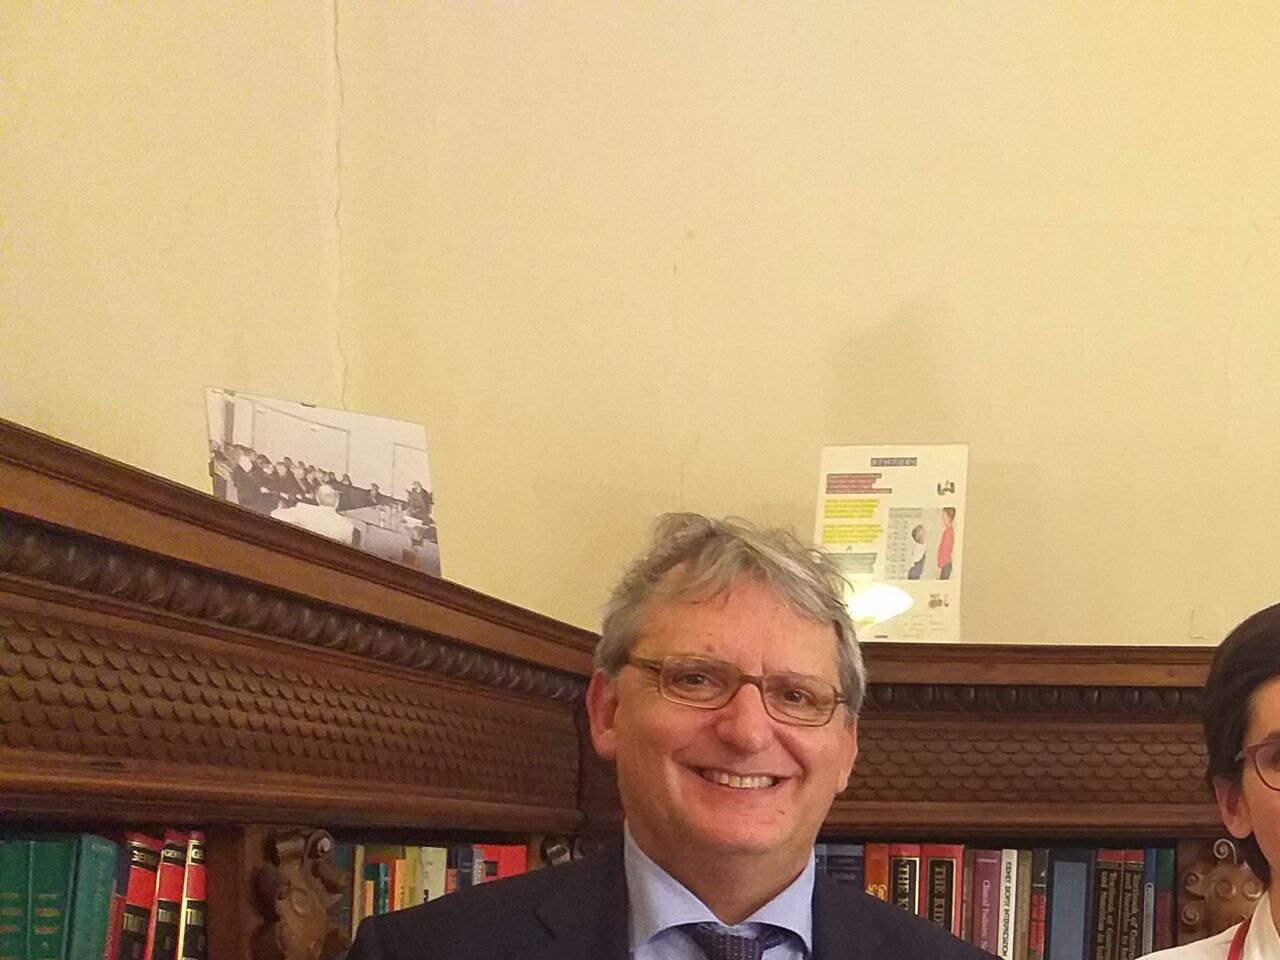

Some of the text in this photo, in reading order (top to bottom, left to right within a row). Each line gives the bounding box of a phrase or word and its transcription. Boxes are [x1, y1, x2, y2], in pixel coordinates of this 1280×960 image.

[933, 865, 946, 928] THE KID
[1001, 861, 1013, 957] KIDNEY BIOPSY INTERPRETATION
